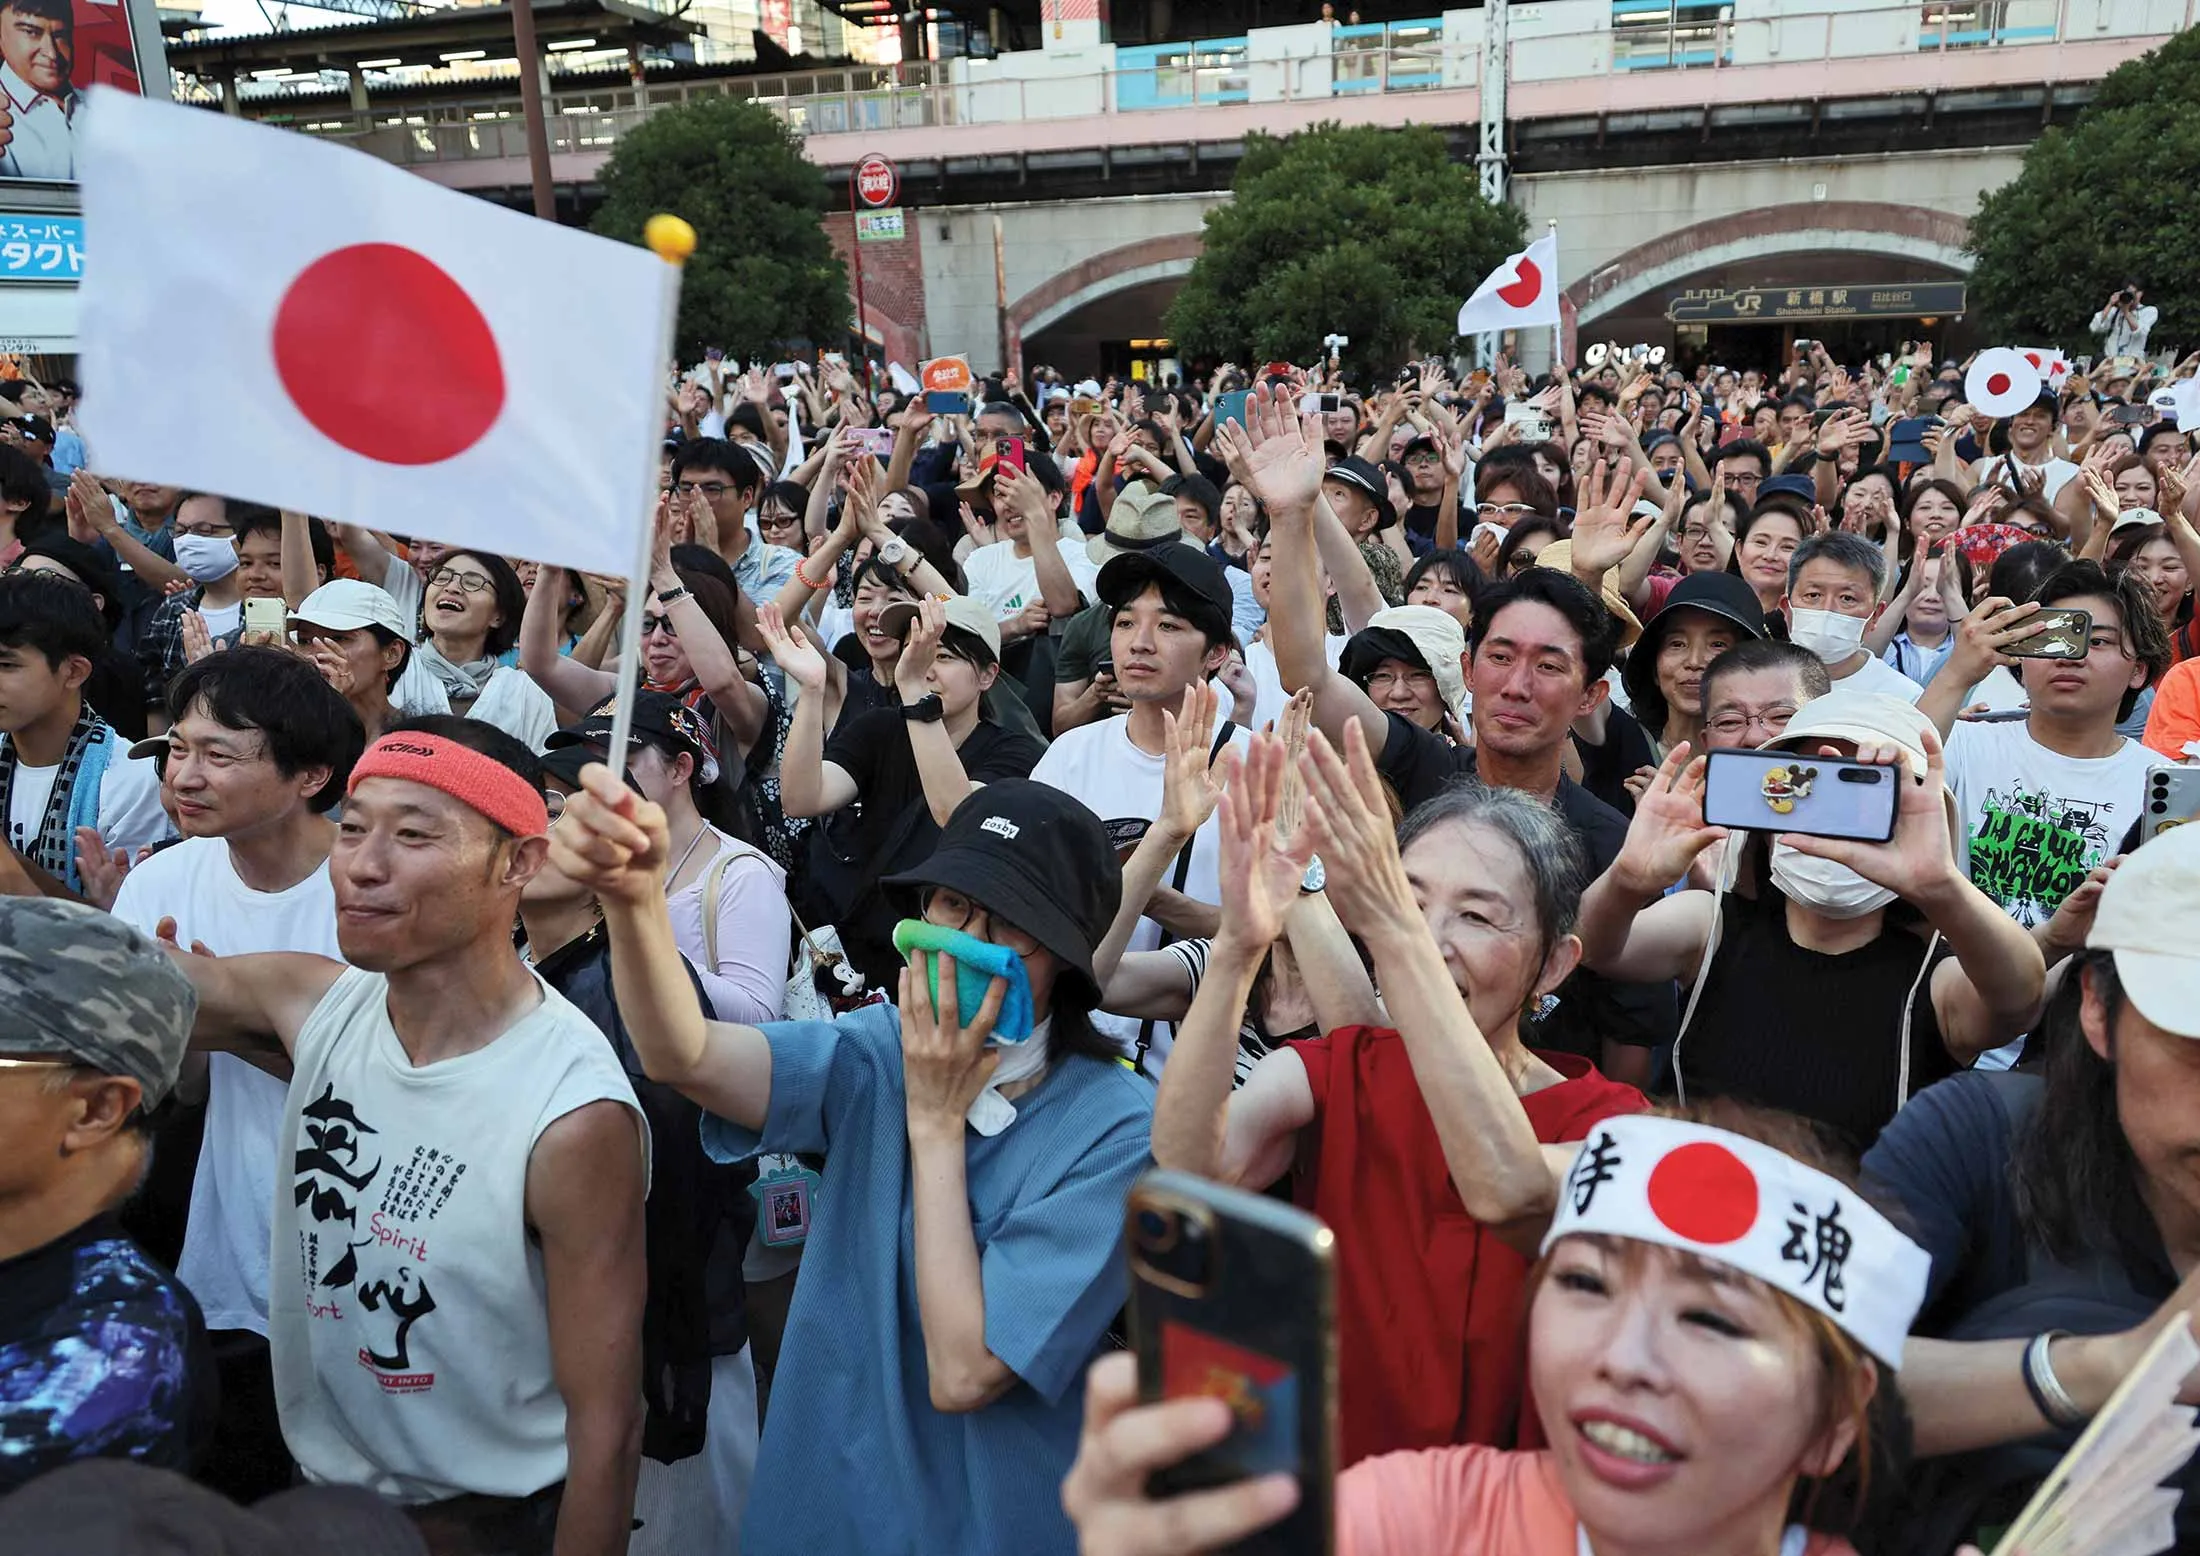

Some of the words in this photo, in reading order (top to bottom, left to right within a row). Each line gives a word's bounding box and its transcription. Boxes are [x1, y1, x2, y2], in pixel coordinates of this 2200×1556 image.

[2, 242, 86, 272] タクト
[1733, 295, 1761, 310] JR
[1786, 288, 1847, 306] 新橋駅
[1776, 307, 1822, 316] Shimbashi
[1824, 305, 1857, 314] Station
[370, 1211, 428, 1262] Spirit
[1781, 1200, 1852, 1313] 魂
